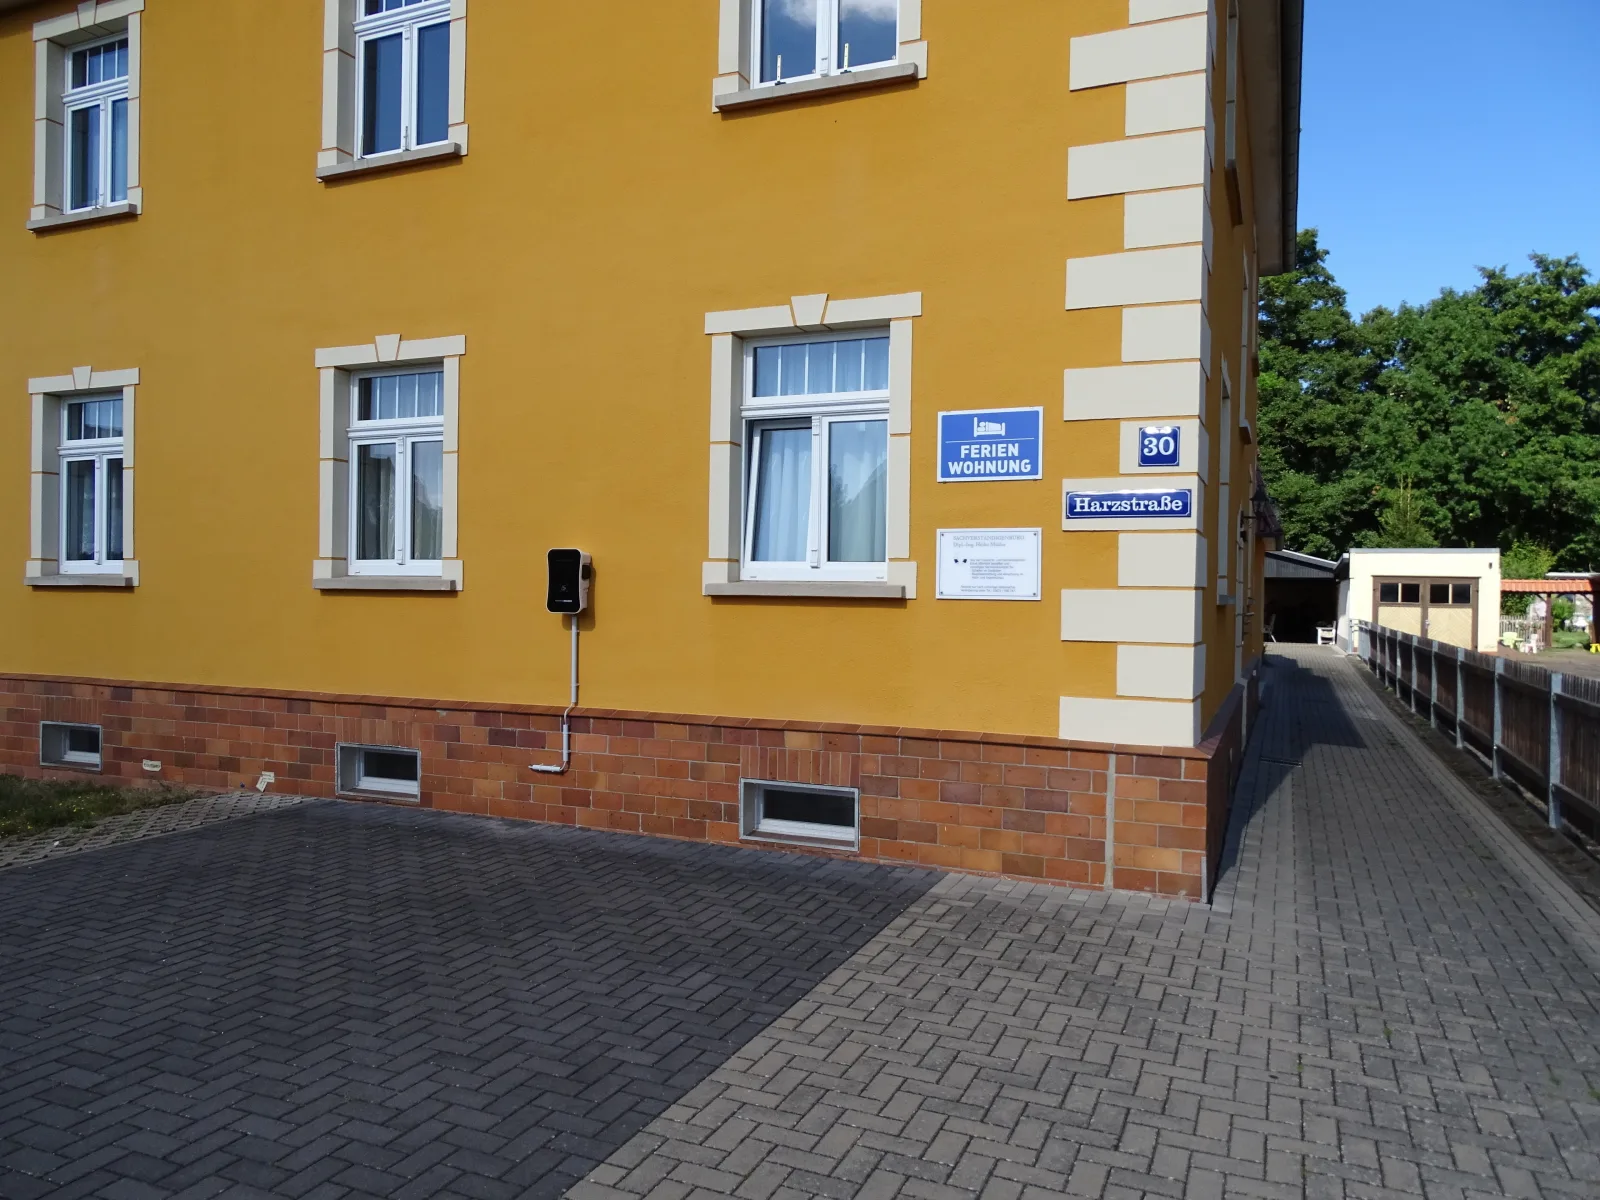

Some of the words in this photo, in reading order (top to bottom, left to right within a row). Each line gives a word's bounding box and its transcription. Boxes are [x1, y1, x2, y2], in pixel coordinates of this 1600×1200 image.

[960, 443, 1019, 459] FERIEN
[1143, 436, 1175, 456] 30
[948, 459, 1032, 475] WOHNUNG
[1073, 496, 1183, 512] Harzstraße
